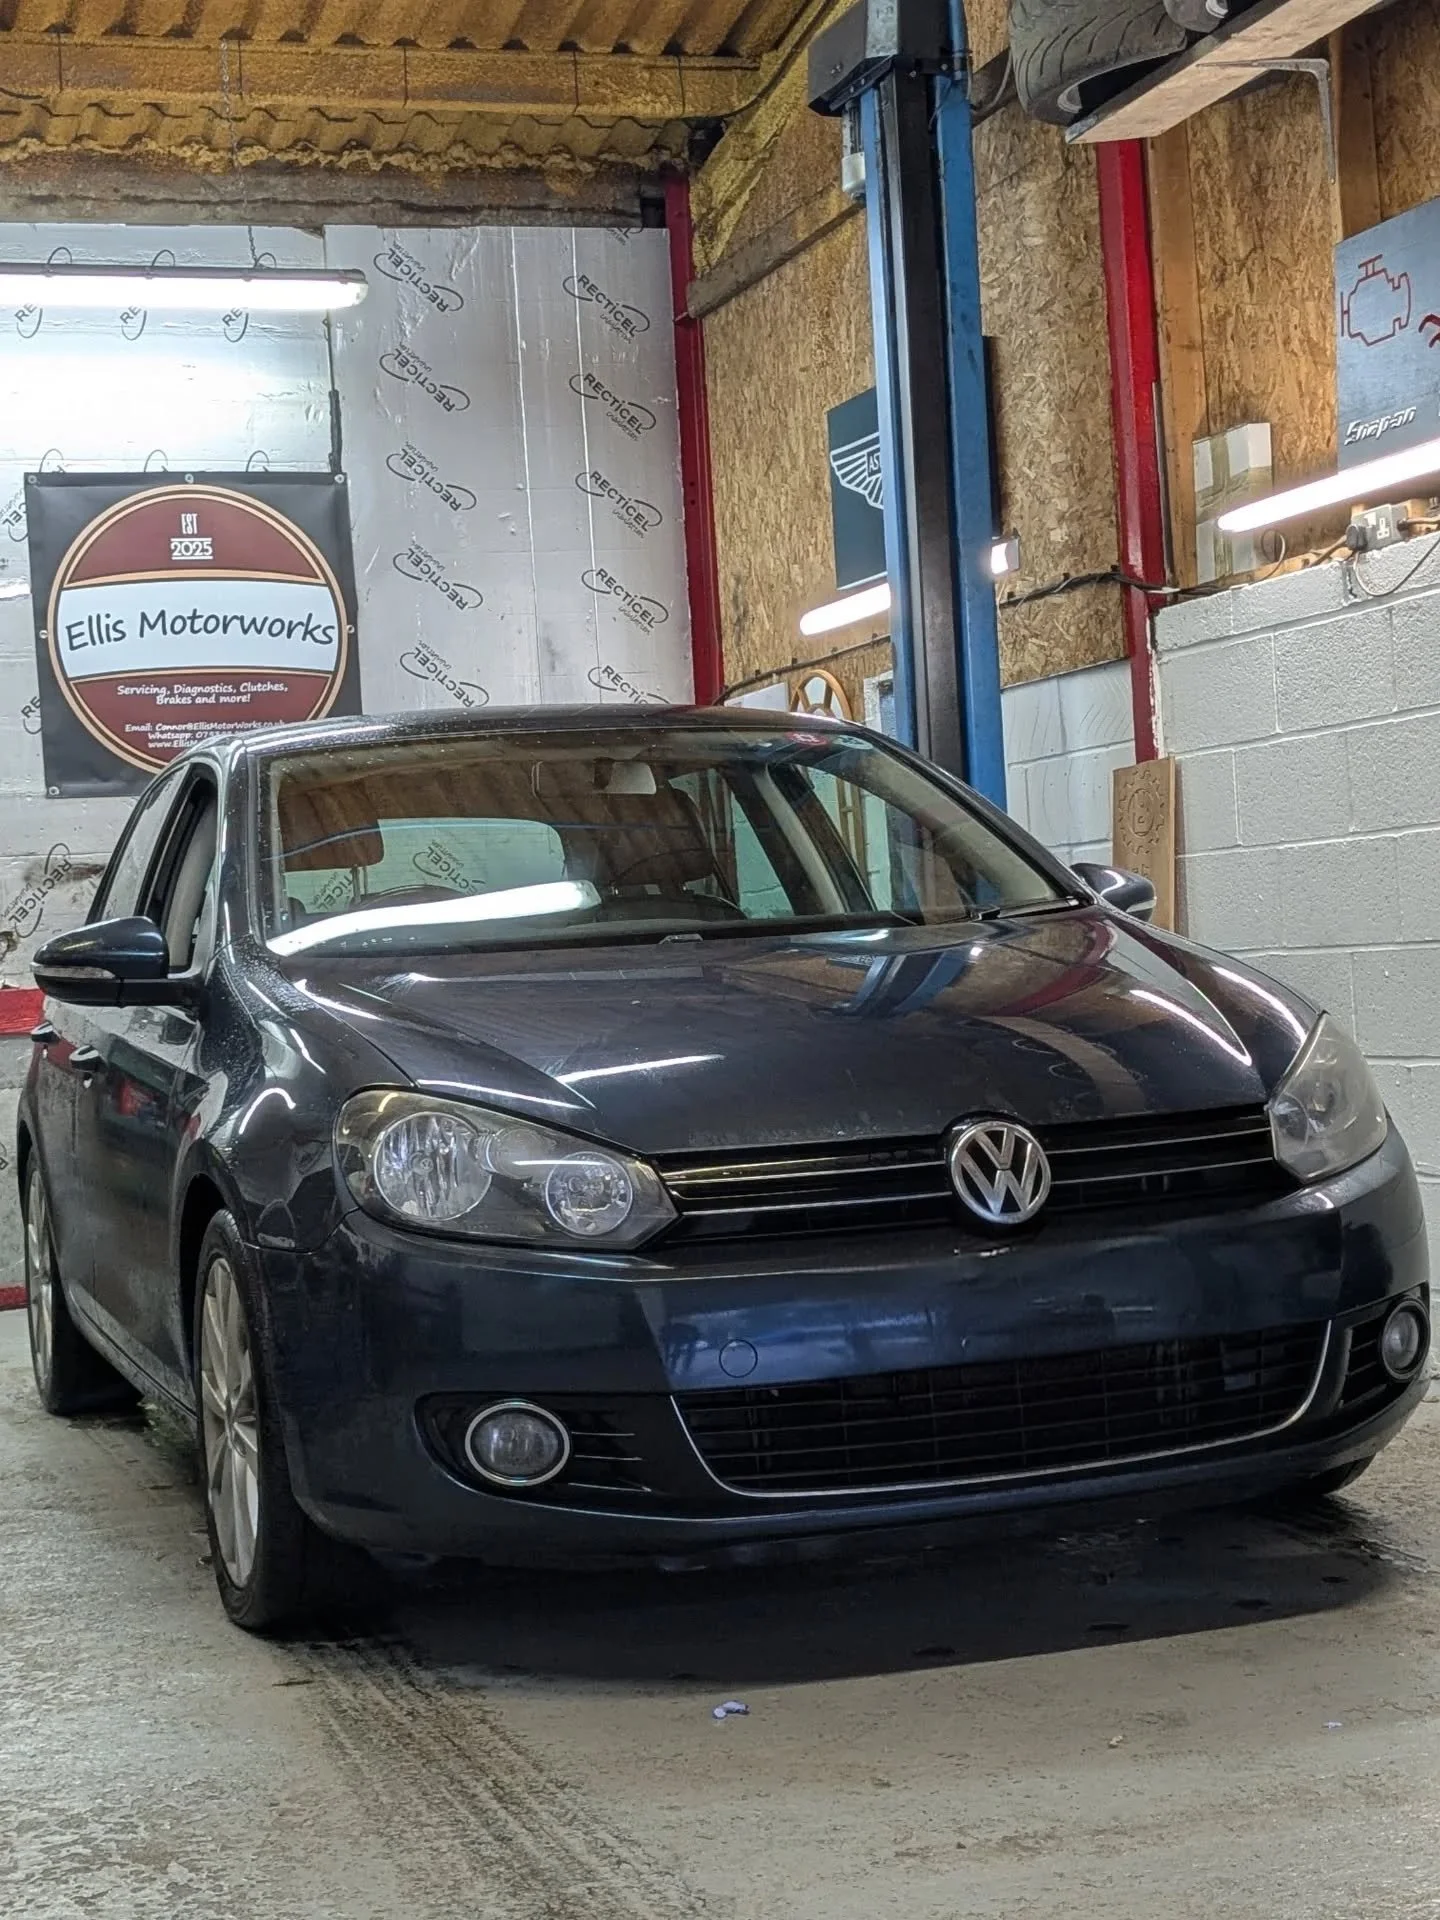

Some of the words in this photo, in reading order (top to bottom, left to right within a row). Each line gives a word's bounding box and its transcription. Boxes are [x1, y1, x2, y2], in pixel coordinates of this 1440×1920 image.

[388, 247, 449, 312] RECTICEL
[577, 274, 637, 337] RECTICEL
[393, 348, 456, 412] RECTICEL
[583, 372, 642, 435] RECTICEL
[400, 448, 462, 511] RECTICEL
[589, 470, 648, 532] RECTICEL
[170, 541, 213, 556] 2025
[181, 513, 198, 535] EST
[407, 547, 469, 610] RECTICEL
[595, 568, 655, 629] RECTICEL
[65, 613, 127, 651] Ellis
[139, 608, 336, 645] Motorworks
[117, 684, 171, 697] Servicing,
[173, 683, 236, 697] Diagnostics,
[240, 681, 288, 693] Clutches,
[156, 694, 192, 705] Brakes
[195, 694, 216, 704] and
[219, 693, 251, 703] more!
[413, 647, 475, 707] RECTICEL
[602, 665, 649, 704] RECTI
[8, 859, 72, 923] RECTICEL
